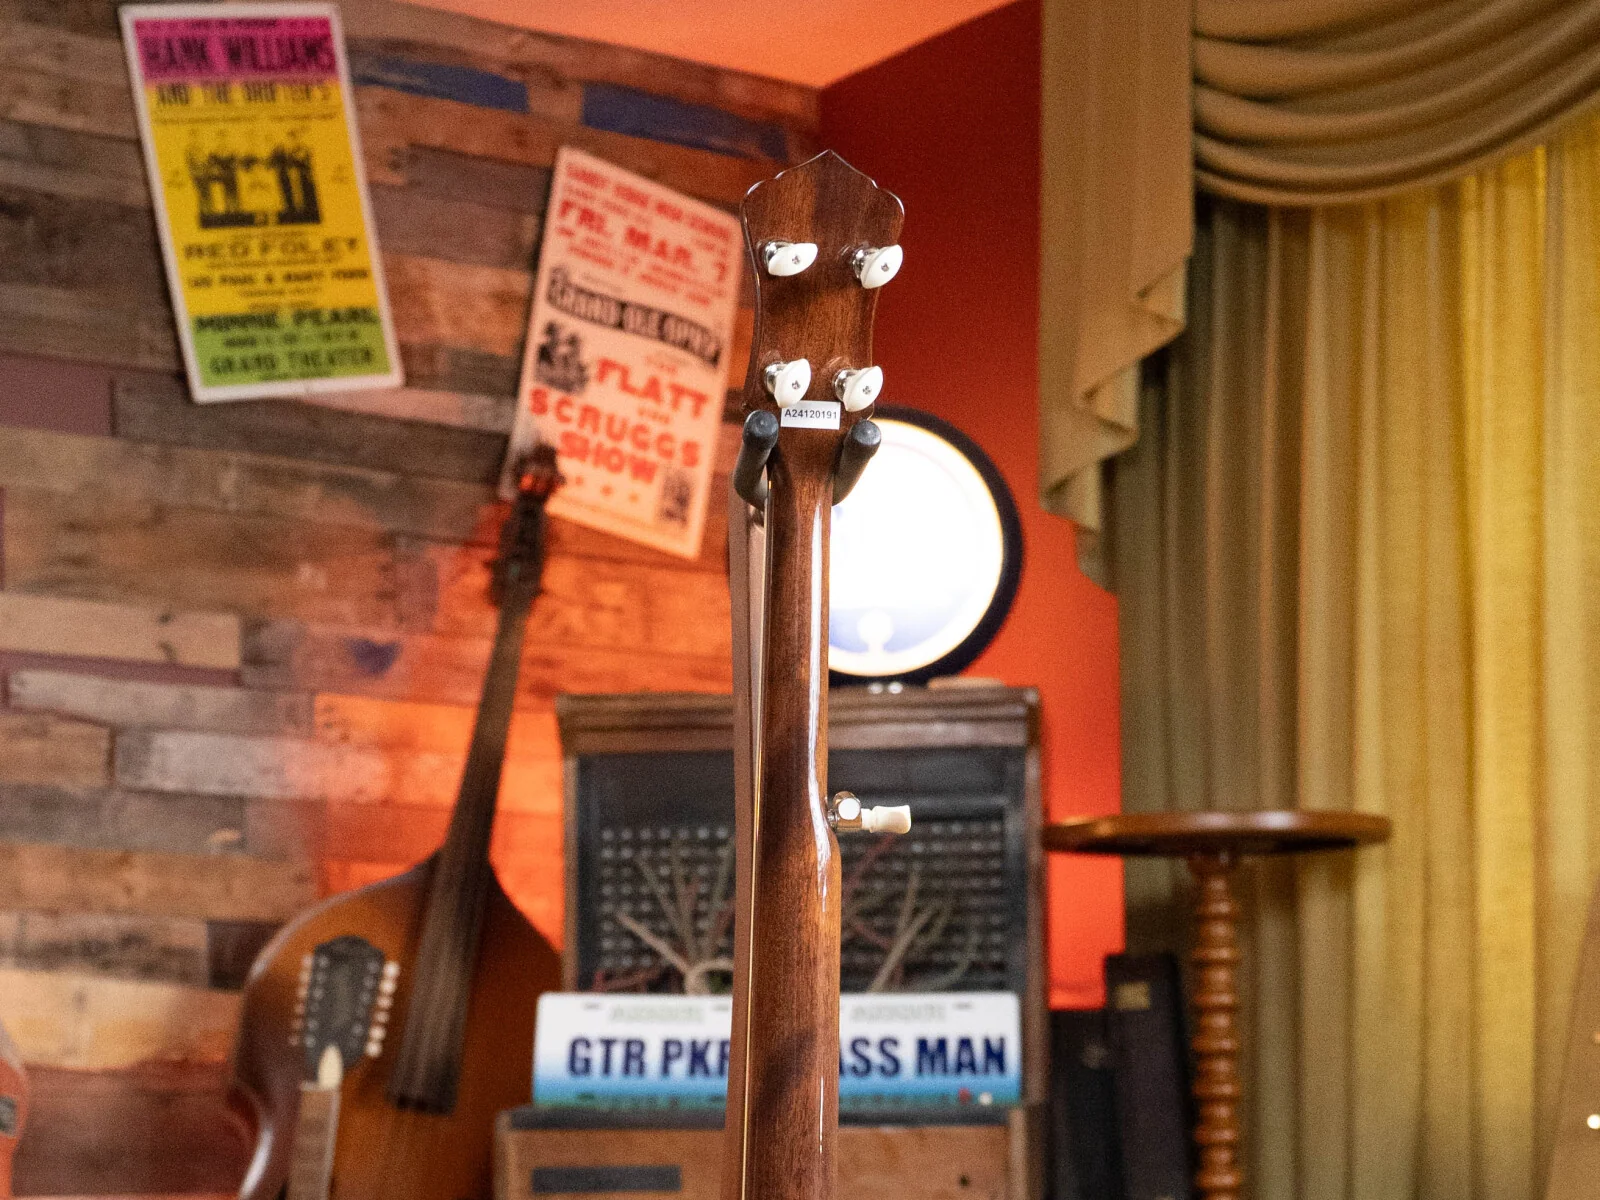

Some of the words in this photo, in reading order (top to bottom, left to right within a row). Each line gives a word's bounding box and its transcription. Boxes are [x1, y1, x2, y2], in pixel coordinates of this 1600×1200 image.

[224, 35, 337, 73] WILLIAMS
[548, 266, 618, 329] GRAND
[596, 357, 709, 418] FLATT
[529, 388, 702, 469] SCRUGGS
[784, 408, 837, 419] A24120191
[558, 429, 659, 484] SHOW
[568, 1037, 647, 1077] GTR
[917, 1036, 1007, 1076] MAN
